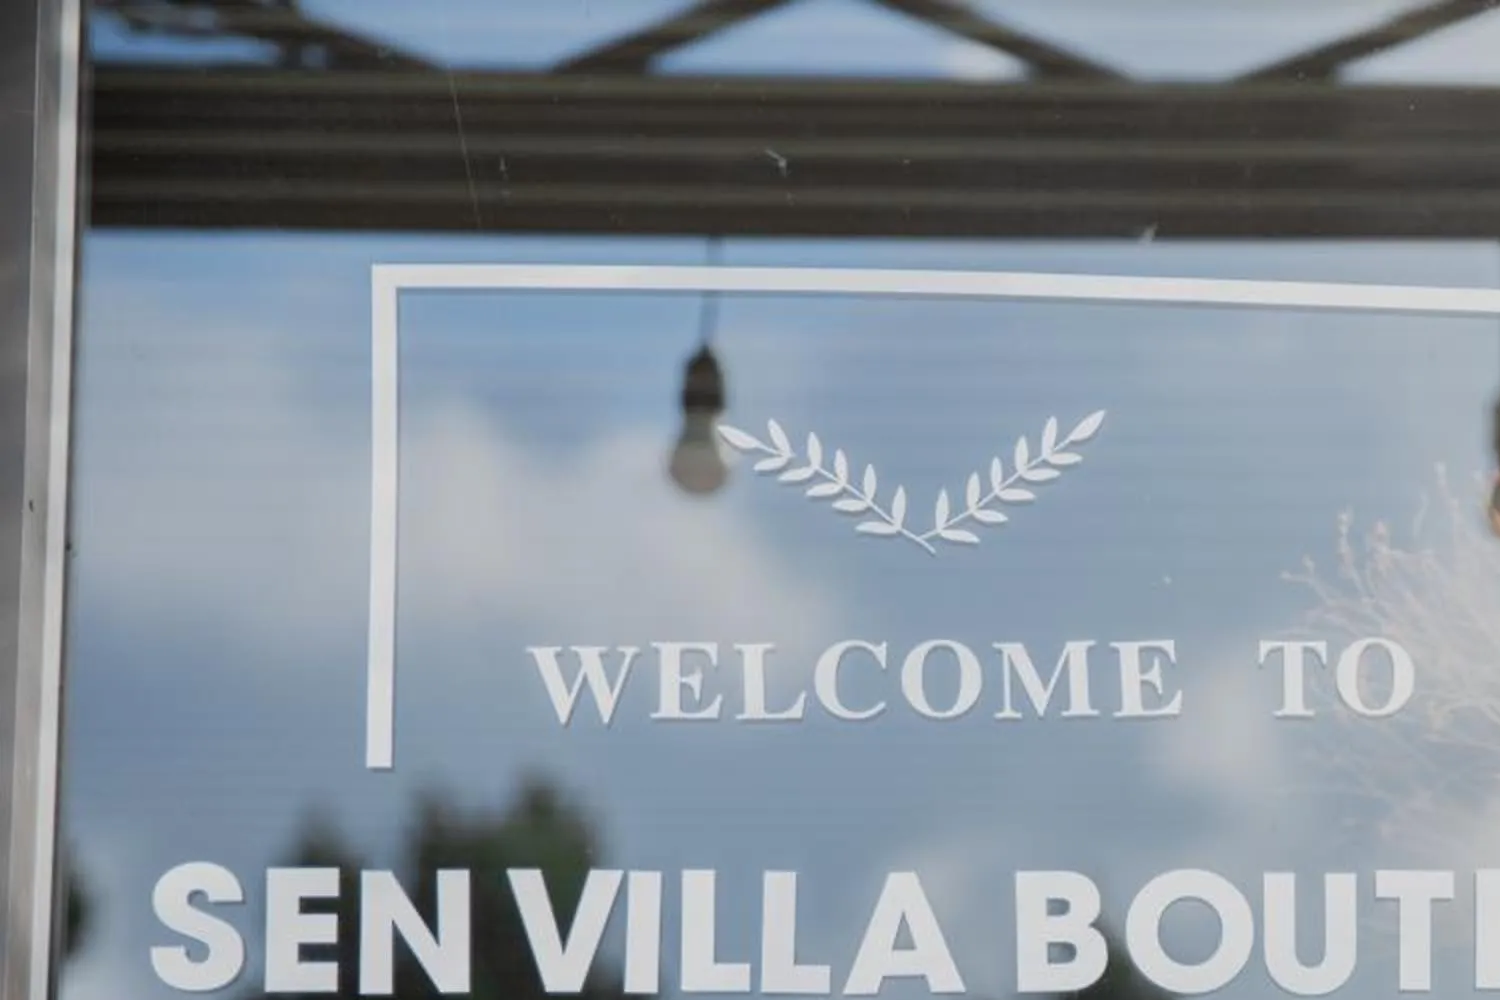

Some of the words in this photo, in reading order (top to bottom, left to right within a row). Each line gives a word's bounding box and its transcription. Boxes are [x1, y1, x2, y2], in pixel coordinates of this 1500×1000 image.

[526, 638, 1184, 727] WELCOME
[1258, 635, 1416, 719] TO
[150, 861, 472, 995] SEN
[505, 868, 966, 996] VILLA
